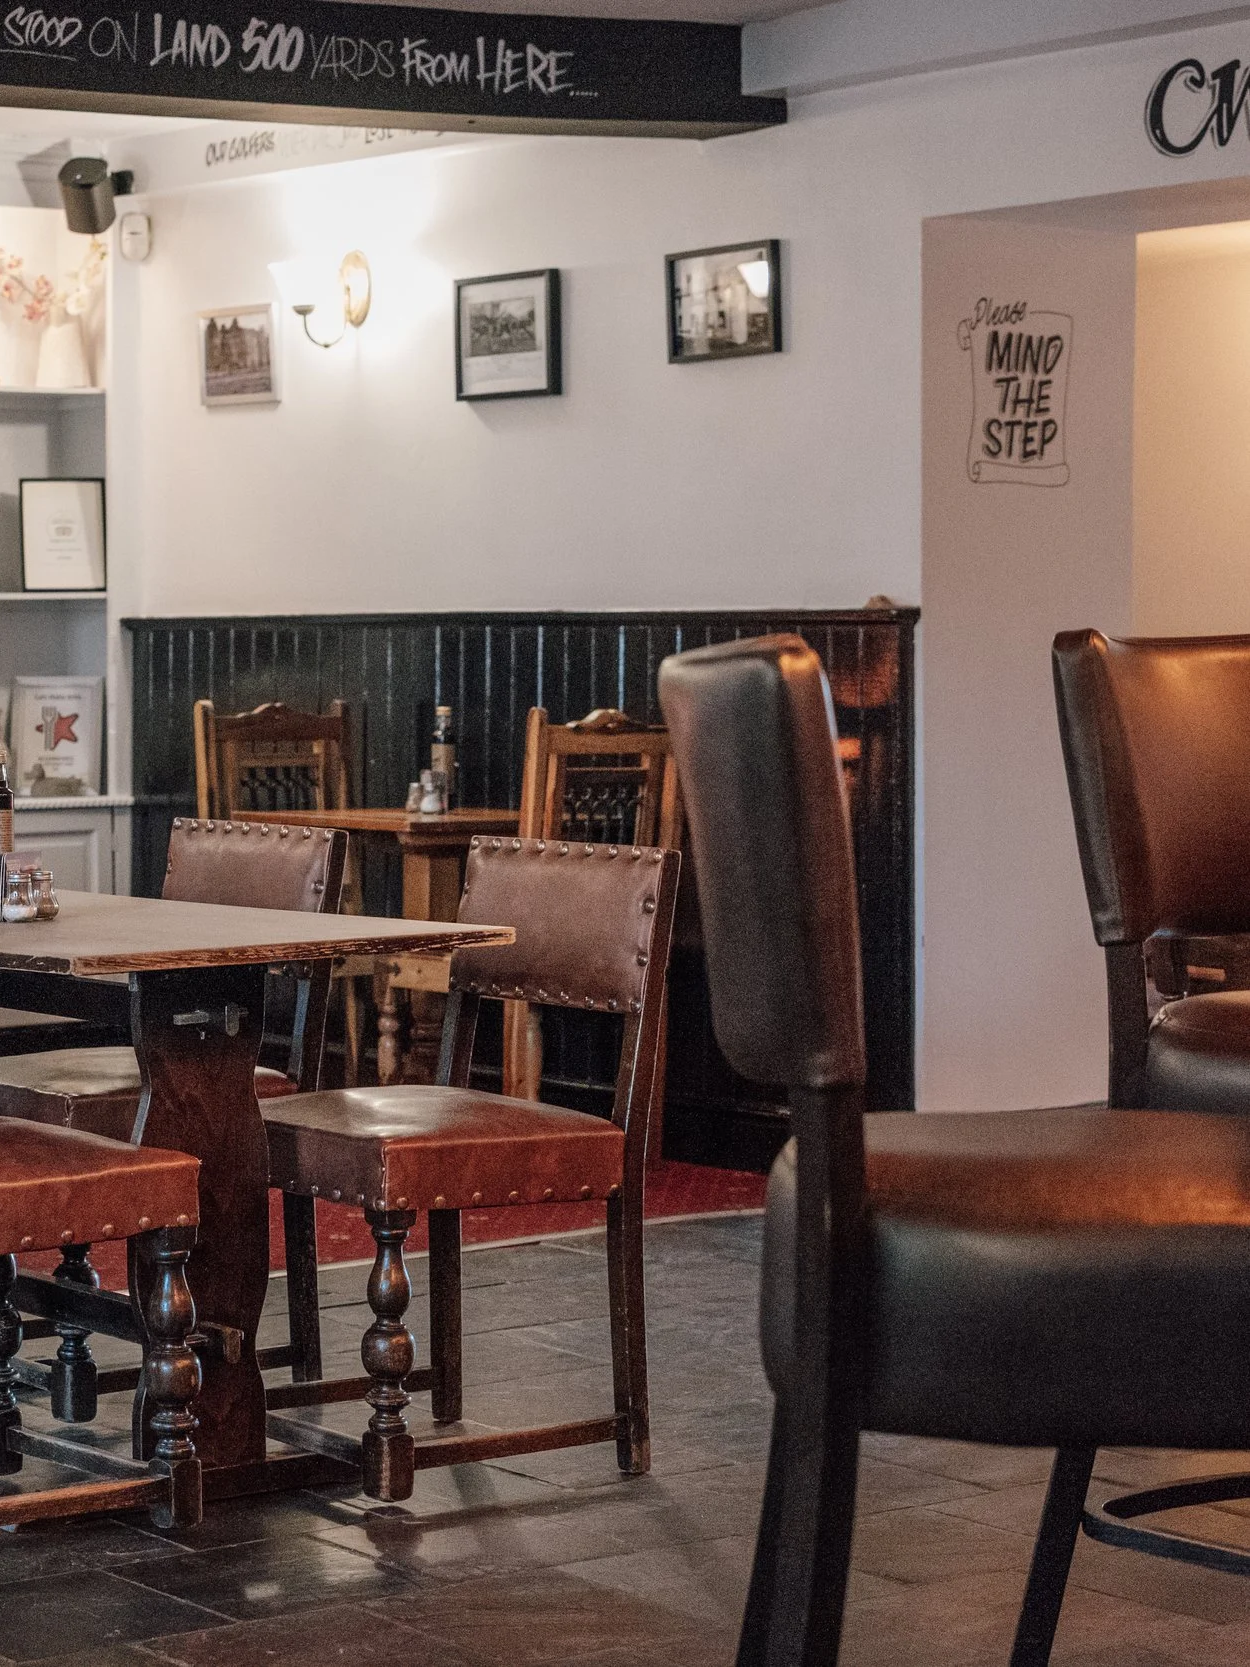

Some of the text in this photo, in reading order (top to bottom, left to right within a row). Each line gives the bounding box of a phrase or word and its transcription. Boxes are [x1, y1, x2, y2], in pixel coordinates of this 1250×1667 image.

[4, 6, 83, 48] STOOD
[88, 11, 139, 63] ON
[150, 13, 232, 68] LAND
[239, 17, 305, 72] 500
[309, 32, 396, 81] YARDS
[400, 37, 471, 87] FROM
[969, 296, 1029, 331] Please
[985, 330, 1064, 375] MIND
[994, 376, 1054, 418] THE
[982, 418, 1059, 463] STEP
